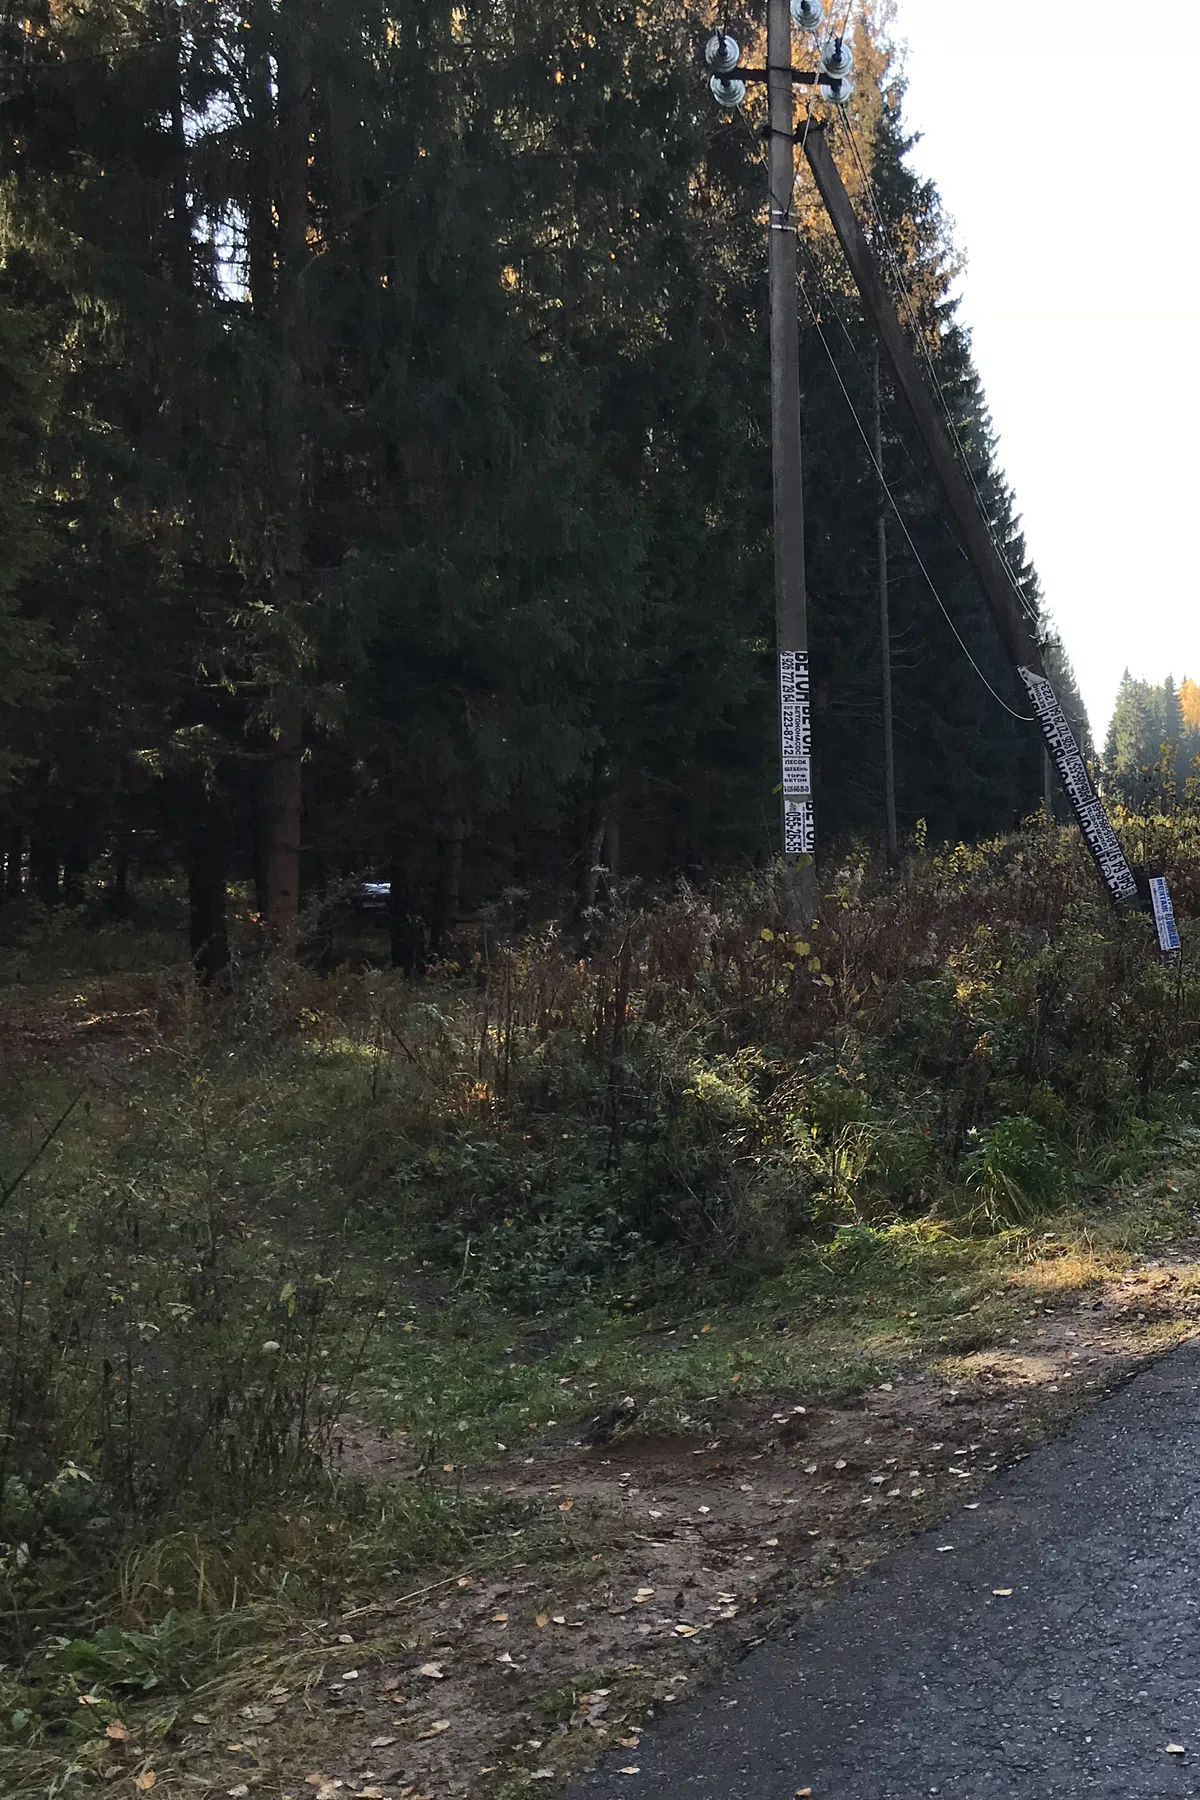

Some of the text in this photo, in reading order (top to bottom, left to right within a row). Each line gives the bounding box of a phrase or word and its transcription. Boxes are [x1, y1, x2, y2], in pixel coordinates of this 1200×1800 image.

[781, 658, 794, 670] 926
[782, 671, 795, 683] 727
[782, 684, 795, 693] 29
[783, 694, 796, 702] 64
[1049, 708, 1062, 717] 64
[1052, 716, 1065, 725] 29
[783, 711, 794, 755] 223-87-12
[1056, 724, 1069, 737] 727
[1061, 736, 1075, 749] 926
[1066, 747, 1077, 755] 8
[786, 811, 801, 852] 055-26-55
[1106, 850, 1121, 862] 97
[1111, 861, 1127, 873] 64
[1117, 872, 1135, 890] 646
[1157, 879, 1169, 912] МОНТАЖ
